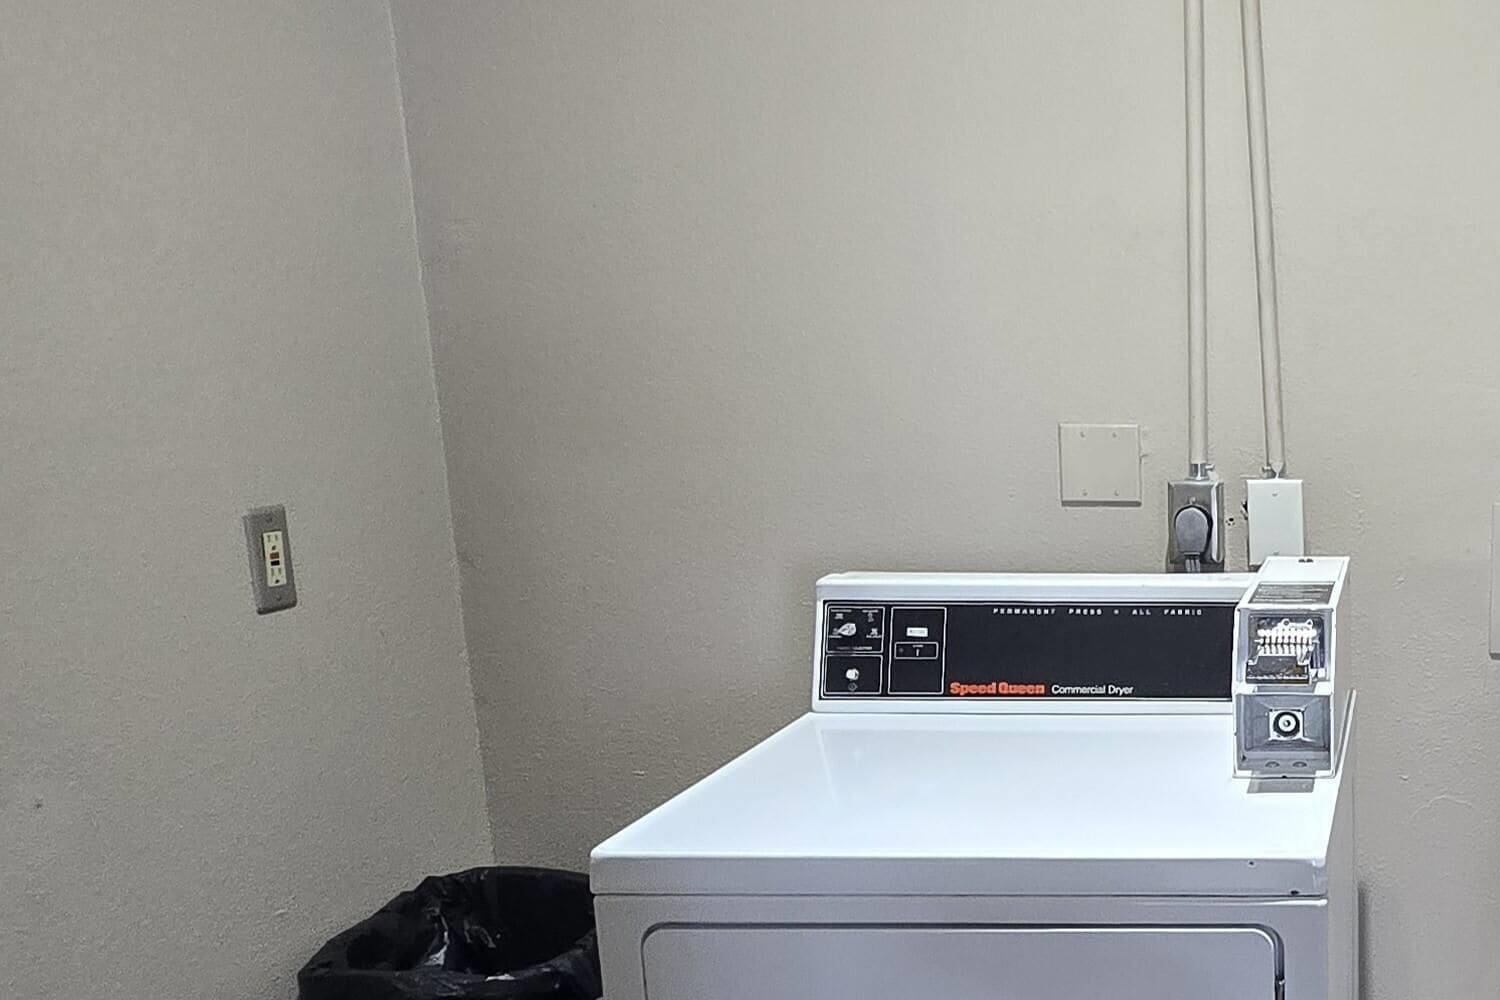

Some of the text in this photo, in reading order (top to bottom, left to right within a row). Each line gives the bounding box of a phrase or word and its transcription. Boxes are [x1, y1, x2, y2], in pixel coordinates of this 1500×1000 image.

[950, 681, 1134, 696] Speed Queen Commercial Dryer
